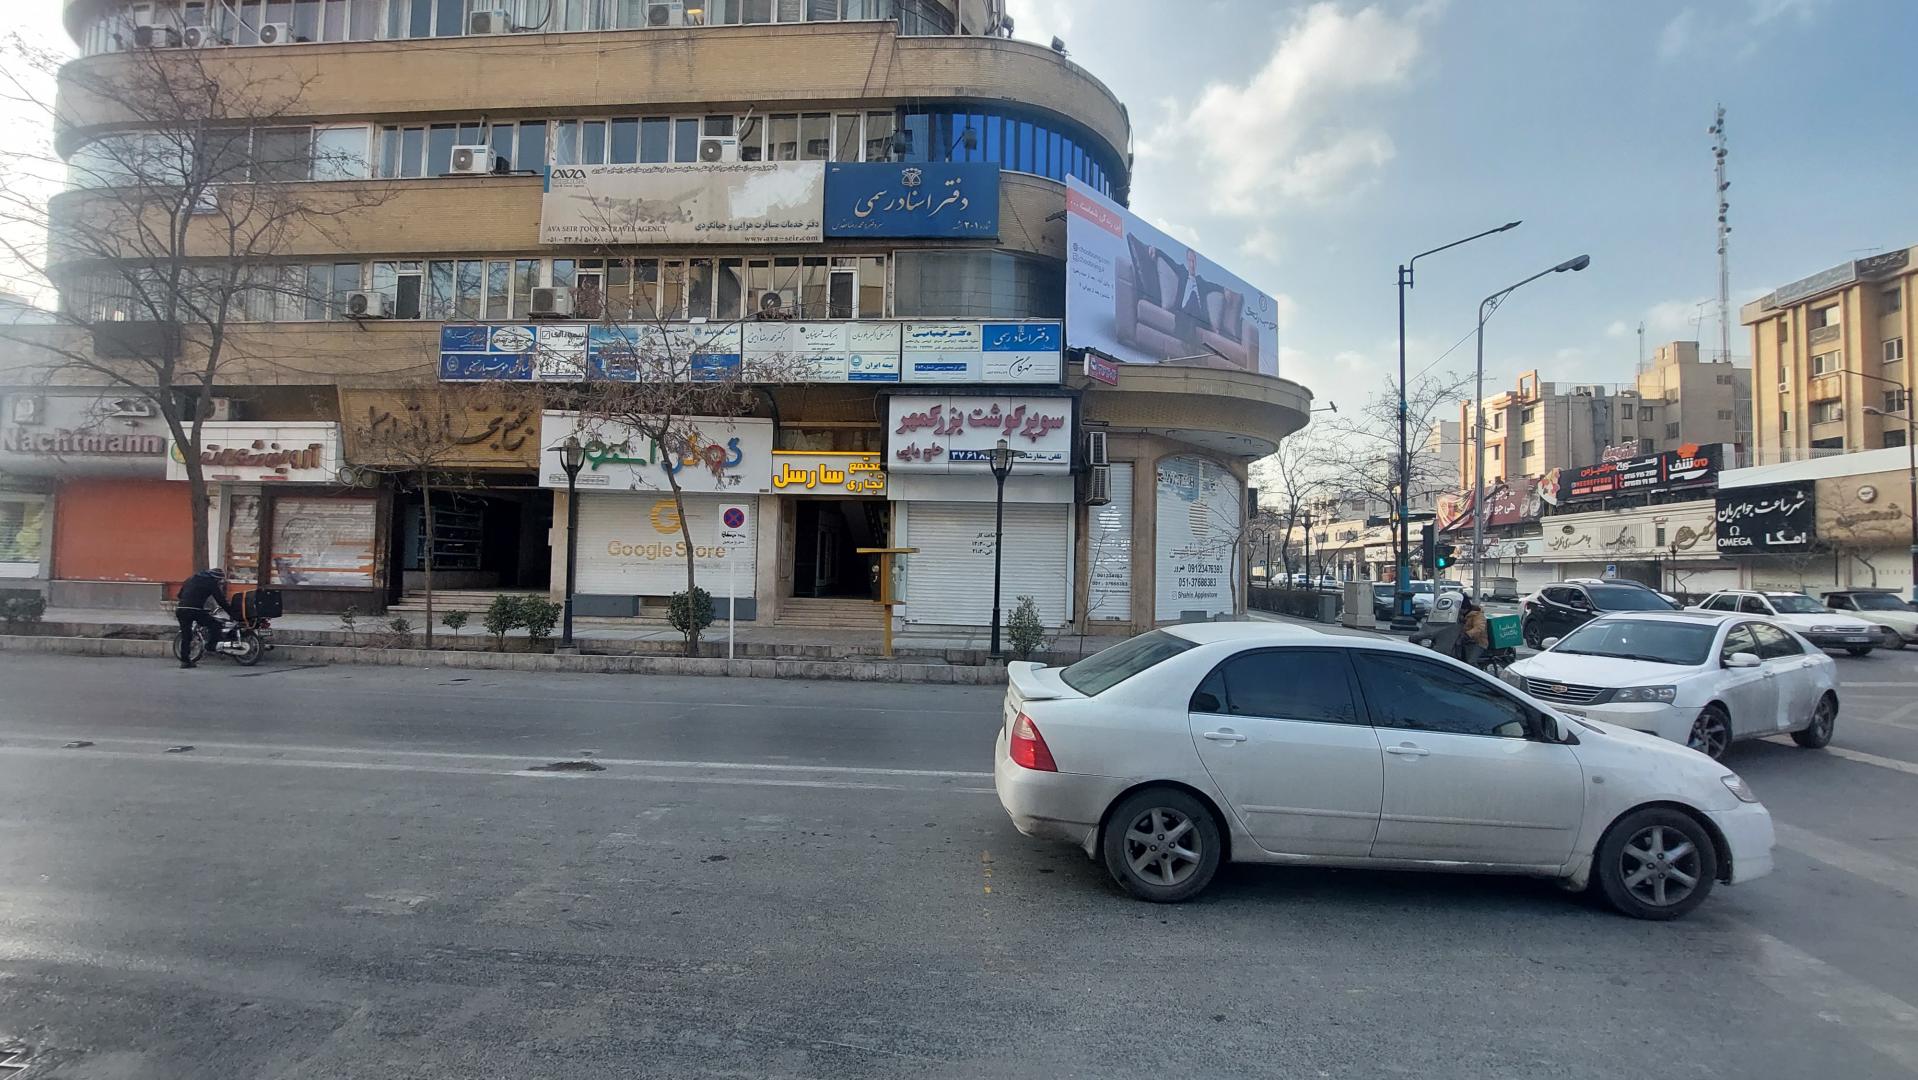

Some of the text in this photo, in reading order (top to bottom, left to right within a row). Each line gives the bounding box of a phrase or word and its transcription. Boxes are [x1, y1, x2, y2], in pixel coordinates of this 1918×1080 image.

[551, 169, 586, 179] AVA
[854, 177, 969, 218] دفتر اسناد رسمی
[638, 225, 667, 233] AGENCY
[695, 220, 727, 231] جهانگردی
[733, 220, 753, 231] هوایی
[755, 220, 779, 231] مسافرت
[781, 219, 803, 229] خدمات
[806, 219, 819, 229] دفتر
[993, 326, 1050, 345] دفتر اسناد رسمی
[865, 361, 881, 369] ایران
[896, 403, 1064, 442] سوپر گوشت بزرگمهر
[1, 427, 167, 456] Nachtmann
[923, 442, 944, 462] حاج
[1047, 452, 1062, 462] تلفن
[773, 463, 845, 488] سارسل
[846, 456, 885, 494] مجتمع تجاری
[1717, 490, 1806, 523] شهر ساعت جواهریان
[1717, 537, 1752, 547] OMEGA
[1766, 530, 1807, 545] امگا
[607, 540, 727, 561] Google Sore
[1178, 591, 1193, 599] Shahin
